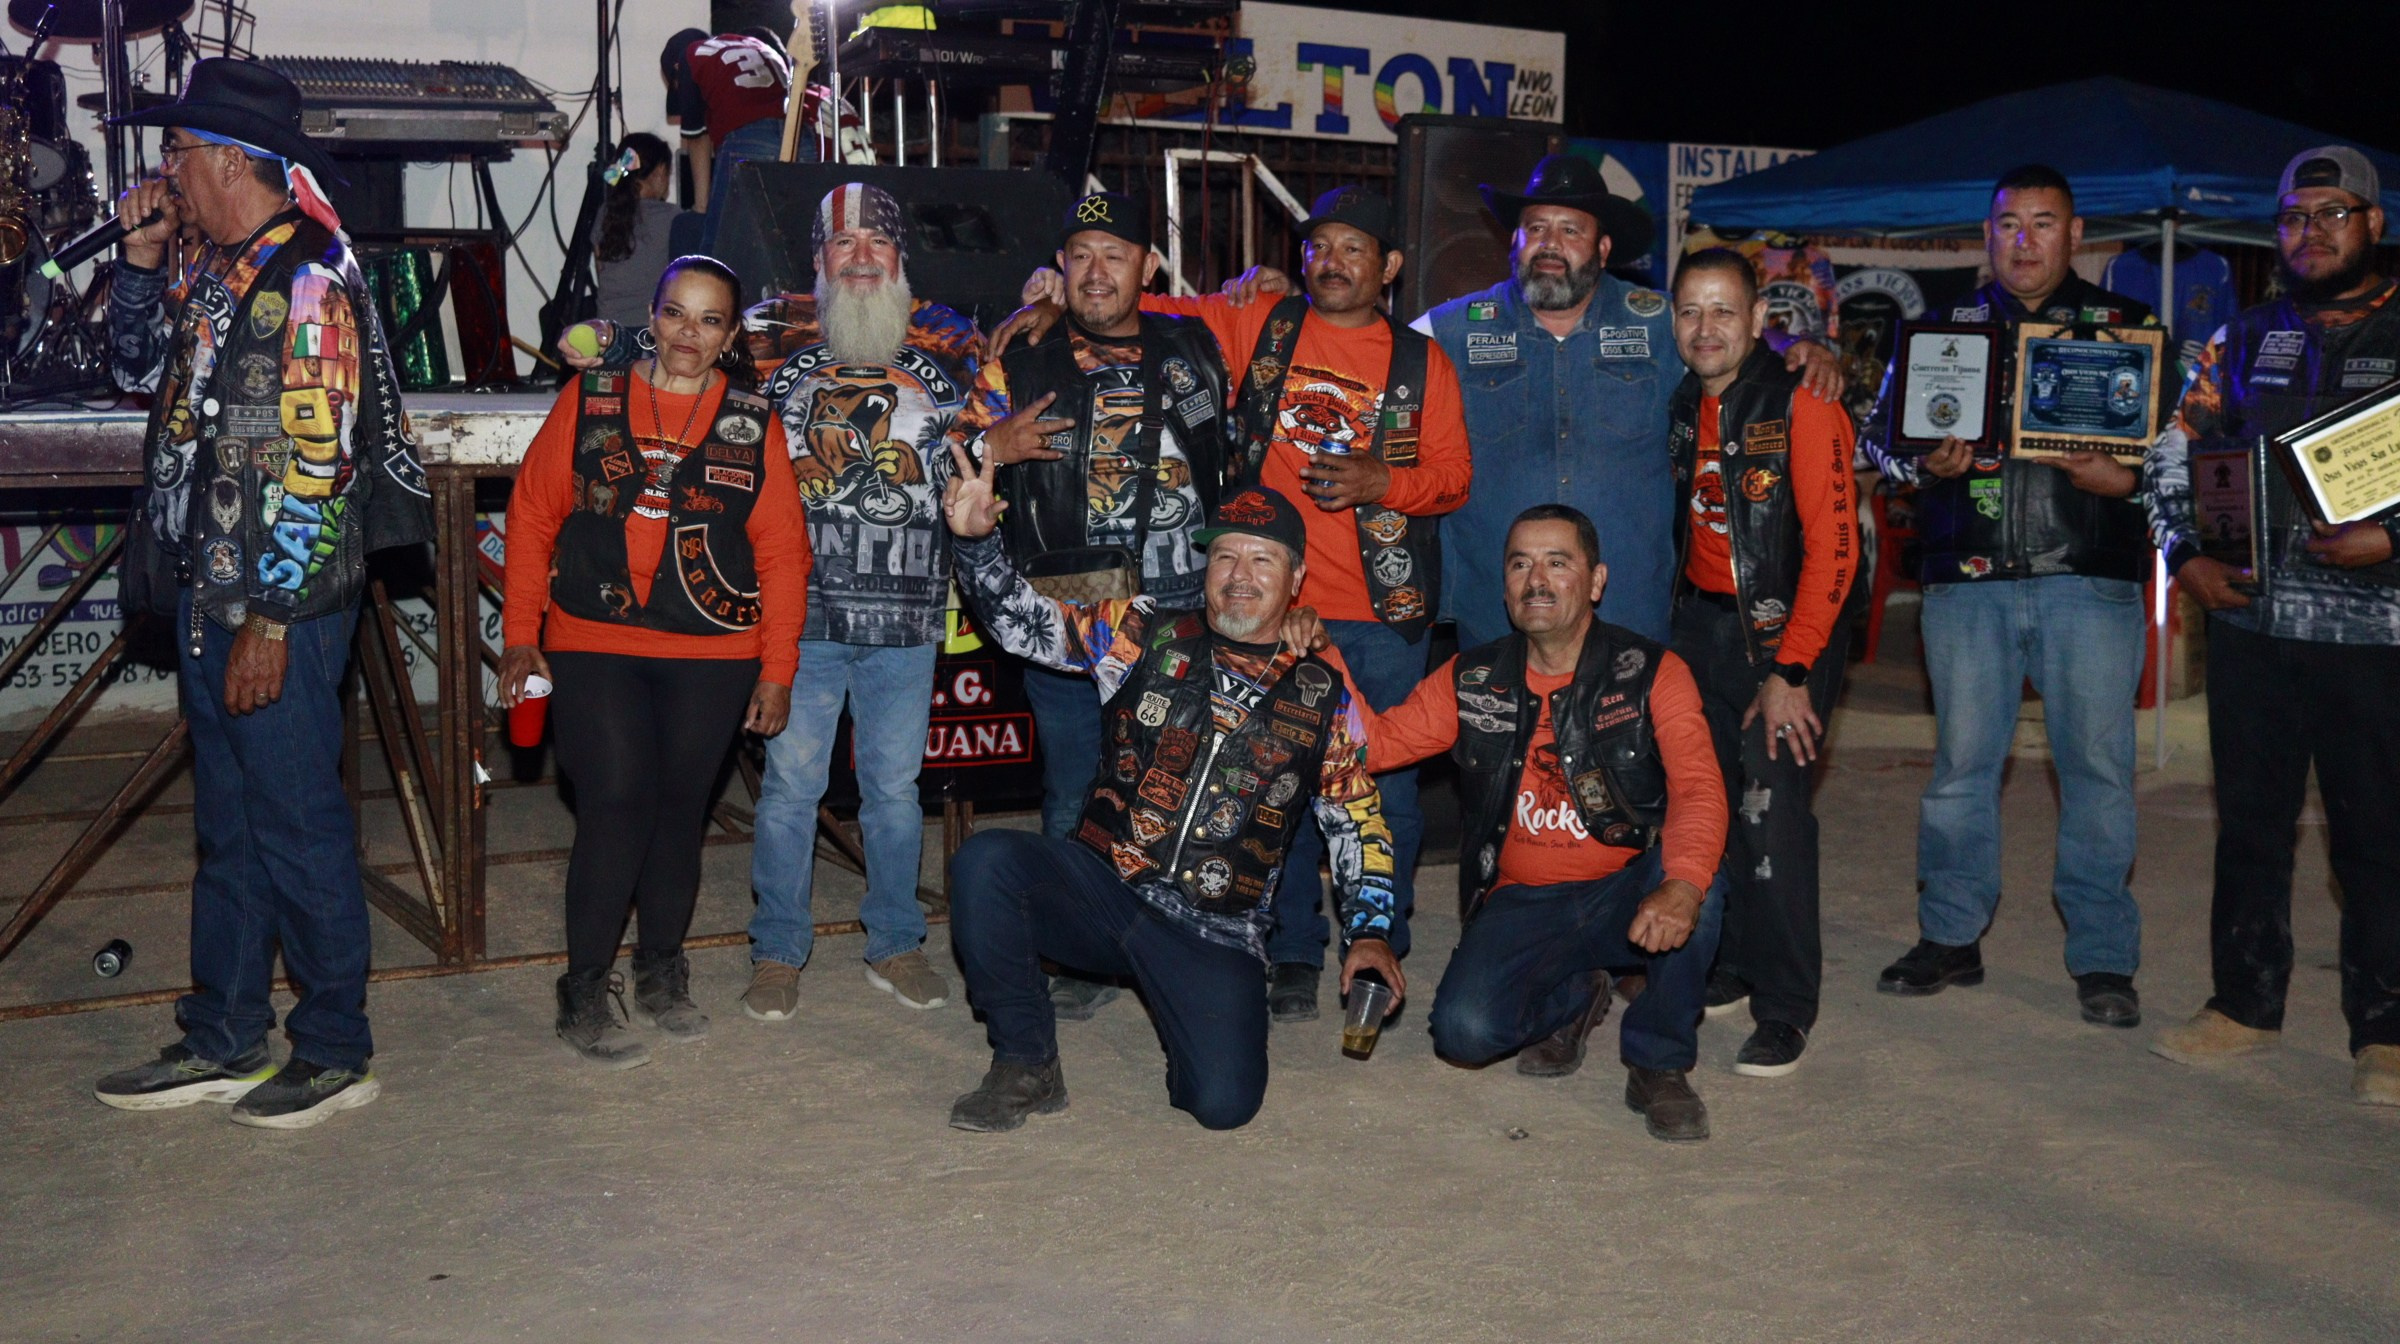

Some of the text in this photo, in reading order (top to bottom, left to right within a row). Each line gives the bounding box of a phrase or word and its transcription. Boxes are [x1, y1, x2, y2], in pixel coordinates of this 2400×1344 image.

[1470, 335, 1513, 346] PERALTA
[1470, 351, 1516, 361] VICEPRESIDENTE
[586, 369, 625, 379] MEXICALI
[894, 348, 950, 393] EJOS
[733, 401, 760, 412] USA
[1293, 390, 1353, 415] Rocky Point
[1385, 403, 1419, 412] MEXICO
[256, 409, 274, 417] POS
[1305, 424, 1327, 435] SLRC
[709, 447, 751, 462] DELYA
[644, 487, 669, 499] SLRC
[1834, 521, 1850, 561] Luis
[1145, 692, 1169, 707] ROUTE
[1140, 709, 1158, 724] 66
[924, 722, 1023, 758] UANA
